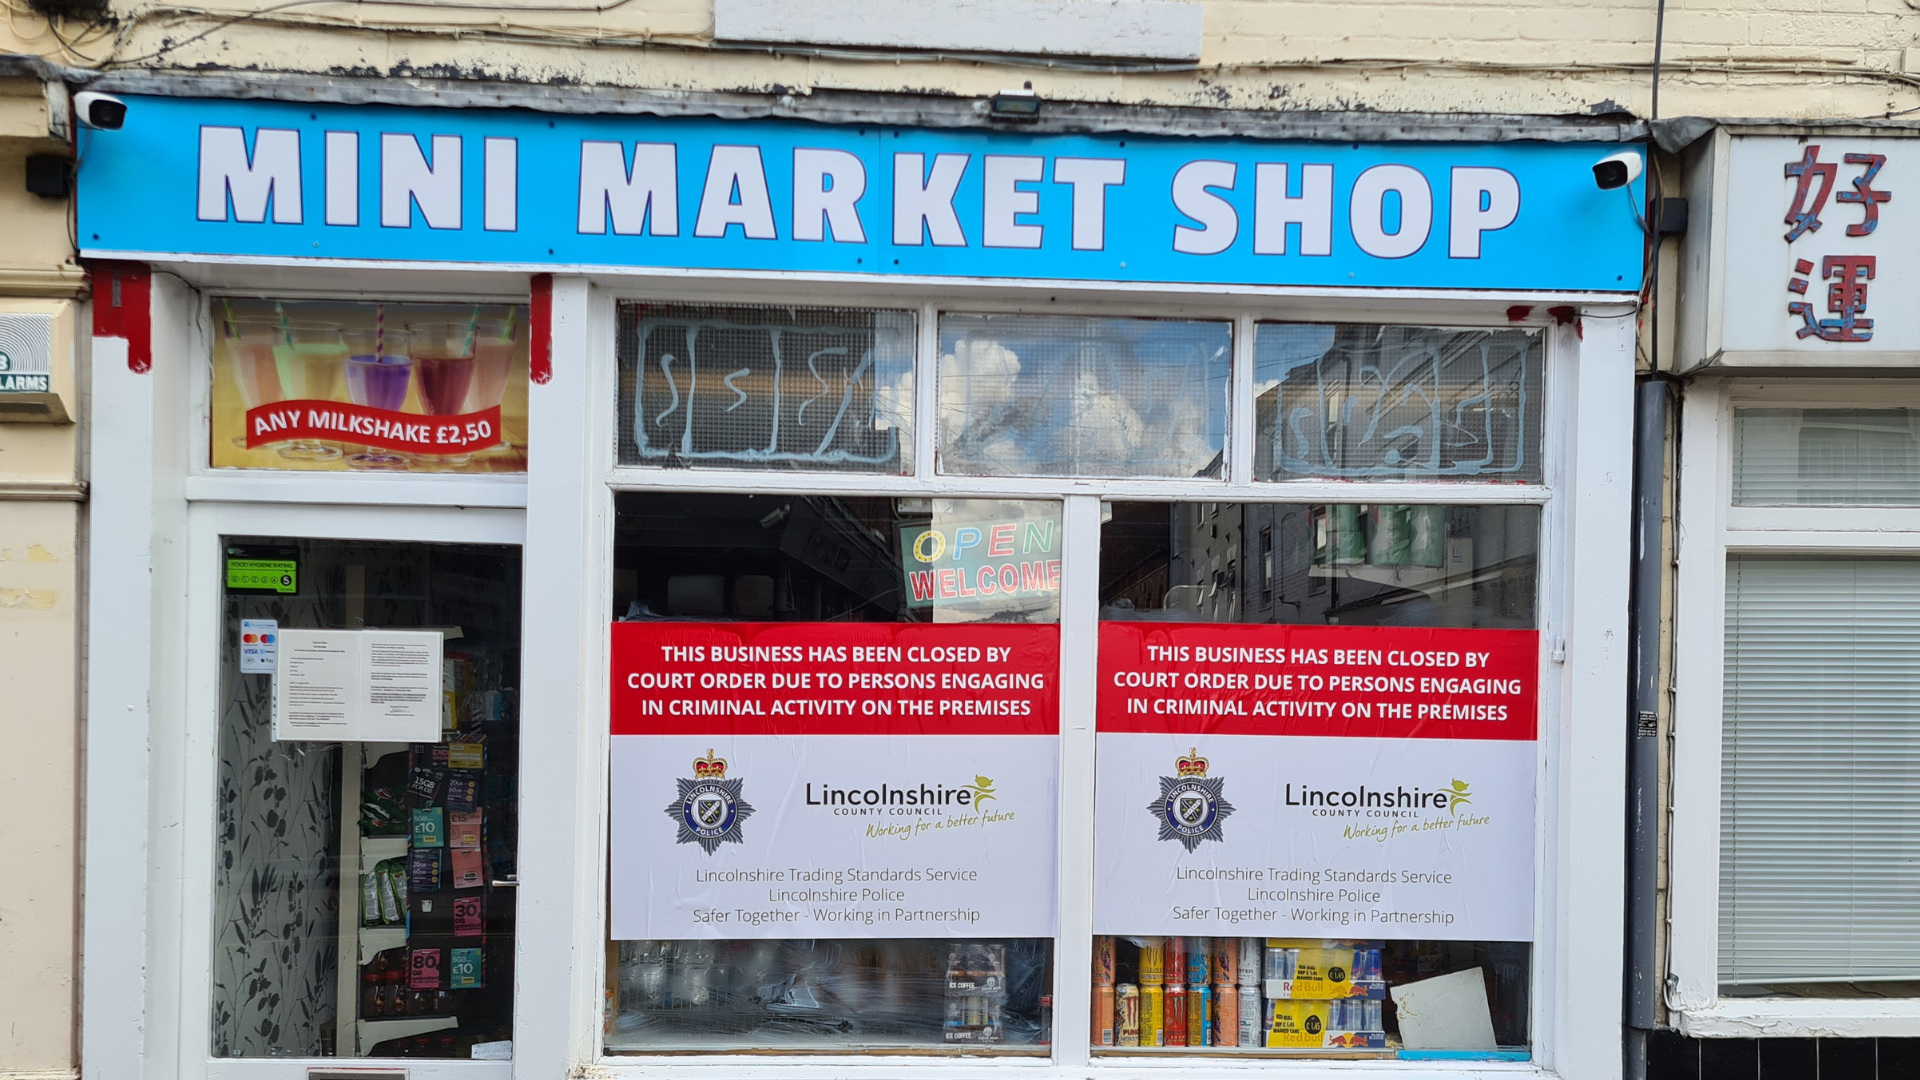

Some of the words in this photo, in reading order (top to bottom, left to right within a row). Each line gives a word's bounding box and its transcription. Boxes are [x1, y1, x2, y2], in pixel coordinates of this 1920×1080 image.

[197, 125, 518, 232] MINI
[577, 141, 1127, 251] MARKET
[1170, 159, 1521, 260] SHOP
[1784, 145, 1892, 342] 好運
[254, 410, 302, 436] ANY
[308, 410, 431, 444] MILKSHAKE
[436, 420, 492, 446] £2,50
[913, 520, 1054, 563] OPEN
[909, 559, 1061, 601] WELCOME
[661, 646, 705, 662] THIS
[711, 646, 803, 662] BUSINESS
[809, 646, 847, 662] HAS
[852, 646, 902, 662] BEEN
[907, 646, 981, 662] CLOSED
[987, 646, 1011, 662] BY
[1147, 645, 1190, 662] THIS
[1196, 647, 1285, 664] BUSINESS
[1291, 648, 1328, 665] HAS
[1334, 649, 1382, 666] BEEN
[1388, 650, 1460, 667] CLOSED
[1466, 652, 1490, 668] BY
[627, 673, 695, 689] COURT
[700, 673, 766, 689] ORDER
[772, 673, 810, 689] DUE
[816, 673, 843, 689] TO
[849, 673, 936, 689] PERSONS
[942, 673, 1044, 690] ENGAGING
[1114, 672, 1179, 688] COURT
[1185, 673, 1249, 690] ORDER
[1255, 674, 1292, 691] DUE
[1298, 675, 1324, 691] TO
[1329, 676, 1415, 693] PERSONS
[1421, 678, 1521, 695] ENGAGING
[642, 699, 663, 715] IN
[669, 699, 765, 715] CRIMINAL
[771, 699, 856, 715] ACTIVITY
[862, 699, 891, 716] ON
[897, 699, 934, 716] THE
[940, 699, 1031, 716] PREMISES
[1127, 698, 1148, 714] IN
[1153, 699, 1248, 715] CRIMINAL
[1253, 700, 1336, 717] ACTIVITY
[1342, 702, 1371, 718] ON
[1377, 703, 1412, 719] THE
[1418, 704, 1508, 721] PREMISES
[414, 777, 435, 789] 15GB
[686, 785, 734, 805] LINCOLNSHIRE
[806, 782, 971, 806] Lincolnshire
[1168, 783, 1214, 804] LINCOLNSHIRE
[1286, 783, 1448, 809] Lincolnshire
[452, 814, 467, 822] £15
[834, 808, 883, 816] COUNTY
[889, 808, 942, 816] COUNCIL
[1312, 809, 1360, 818] COUNTY
[1366, 809, 1419, 818] COUNCIL
[415, 822, 435, 833] £10
[695, 826, 724, 836] POLICE
[866, 820, 912, 841] Working
[915, 818, 932, 836] for
[935, 821, 944, 829] a
[947, 812, 979, 829] better
[981, 809, 1015, 828] future
[1176, 824, 1205, 834] POLICE
[1343, 822, 1388, 843] Working
[1391, 820, 1408, 838] for
[1422, 816, 1454, 831] better
[1457, 813, 1490, 831] future
[696, 868, 784, 882] Lincolnshire
[788, 868, 843, 885] Trading
[847, 868, 921, 881] Standards
[926, 868, 978, 881] Service
[1176, 867, 1263, 881] Lincolnshire
[1267, 868, 1320, 885] Trading
[1324, 869, 1397, 883] Standards
[1401, 870, 1452, 884] Service
[769, 888, 858, 902] Lincolnshire
[863, 888, 905, 902] Police
[1248, 887, 1334, 901] Lincolnshire
[1338, 889, 1381, 902] Police
[455, 904, 477, 917] 30
[693, 908, 731, 923] Safer
[734, 909, 800, 926] Together
[813, 908, 874, 925] Working
[878, 908, 890, 921] in
[895, 908, 980, 924] Partnership
[1173, 906, 1210, 920] Safer
[1214, 907, 1278, 924] Together
[1291, 909, 1349, 925] Working
[1354, 909, 1366, 922] in
[1371, 909, 1455, 927] Partnership
[413, 955, 437, 969] 80
[453, 963, 473, 974] £10
[1283, 982, 1302, 992] Red
[1304, 982, 1323, 992] Bull
[1311, 1022, 1320, 1030] 1.45
[1283, 1033, 1302, 1042] Red
[1304, 1033, 1323, 1042] Bull
